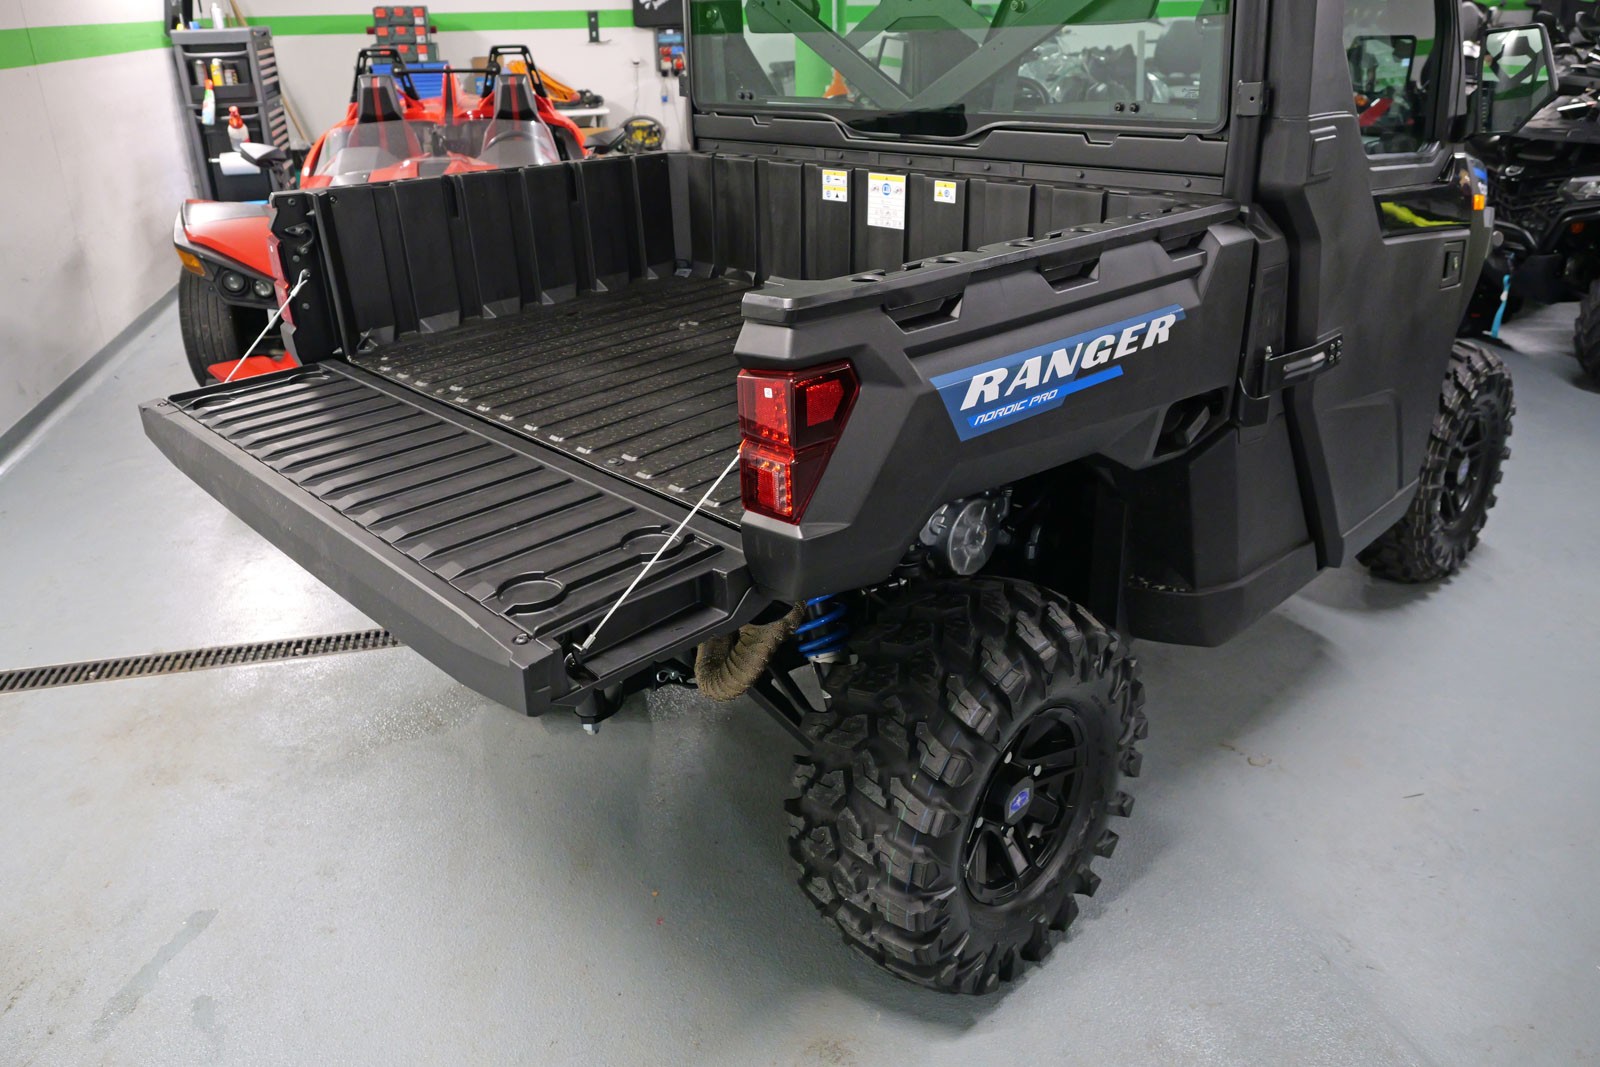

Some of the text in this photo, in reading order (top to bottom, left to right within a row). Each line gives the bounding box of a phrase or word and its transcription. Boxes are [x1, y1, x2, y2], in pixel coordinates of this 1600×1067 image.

[960, 313, 1176, 411] RANGER
[974, 388, 1058, 426] NORDIC PRO
